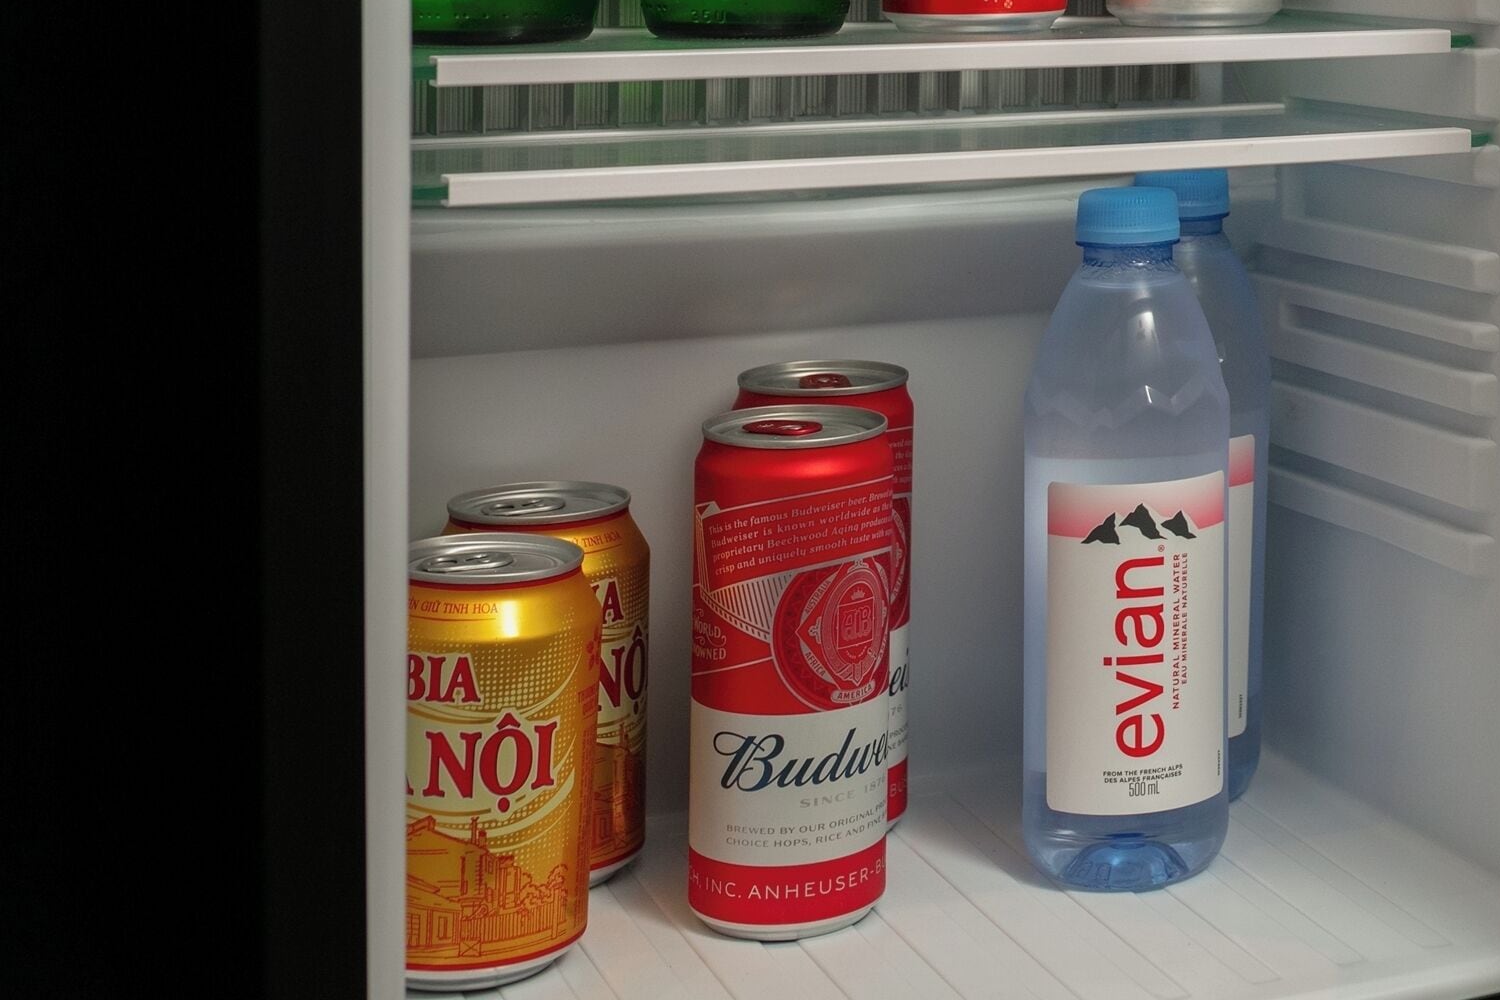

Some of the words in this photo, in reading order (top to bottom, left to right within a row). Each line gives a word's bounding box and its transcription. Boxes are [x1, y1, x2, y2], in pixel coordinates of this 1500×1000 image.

[709, 523, 723, 535] This
[725, 521, 732, 531] is
[734, 519, 748, 529] the
[750, 513, 788, 527] famous
[791, 502, 845, 518] Budweiser
[848, 497, 868, 506] beer.
[711, 531, 759, 548] Budweiser
[763, 527, 773, 536] is
[777, 520, 815, 533] known
[820, 507, 871, 526] worldwide
[583, 536, 605, 548] TINH
[713, 544, 764, 562] proprietary
[768, 529, 828, 549] Beechwood
[832, 525, 859, 535] Aging
[715, 564, 735, 576] crisp
[737, 557, 756, 569] and
[759, 548, 806, 564] uniquely
[809, 540, 847, 554] smooth
[850, 534, 870, 545] taste
[1173, 554, 1181, 593] WATER
[443, 602, 469, 614] TINH
[472, 603, 498, 615] HOA
[805, 579, 832, 614] AUSTRALIA
[1172, 598, 1181, 650] MINERAL
[695, 646, 726, 660] OWNED
[804, 651, 826, 677] AFRICA
[1103, 556, 1165, 758] evian
[837, 684, 873, 701] AMERICA
[1172, 655, 1180, 710] NATURAL
[422, 712, 558, 813] NỘI
[1140, 767, 1167, 776] FRENCH
[1168, 764, 1183, 772] ALPS
[1142, 770, 1182, 781] FRANÇAISES
[800, 790, 856, 808] SINCE
[1129, 781, 1146, 797] 500
[727, 824, 775, 835] BREWED
[780, 826, 795, 835] BY
[800, 824, 825, 833] OUR
[829, 809, 874, 829] ORIGINAL
[726, 837, 769, 848] CHOICE
[774, 838, 813, 848] HOPS,
[816, 832, 842, 844] RICE
[846, 825, 865, 837] AND
[706, 880, 741, 899] INC.
